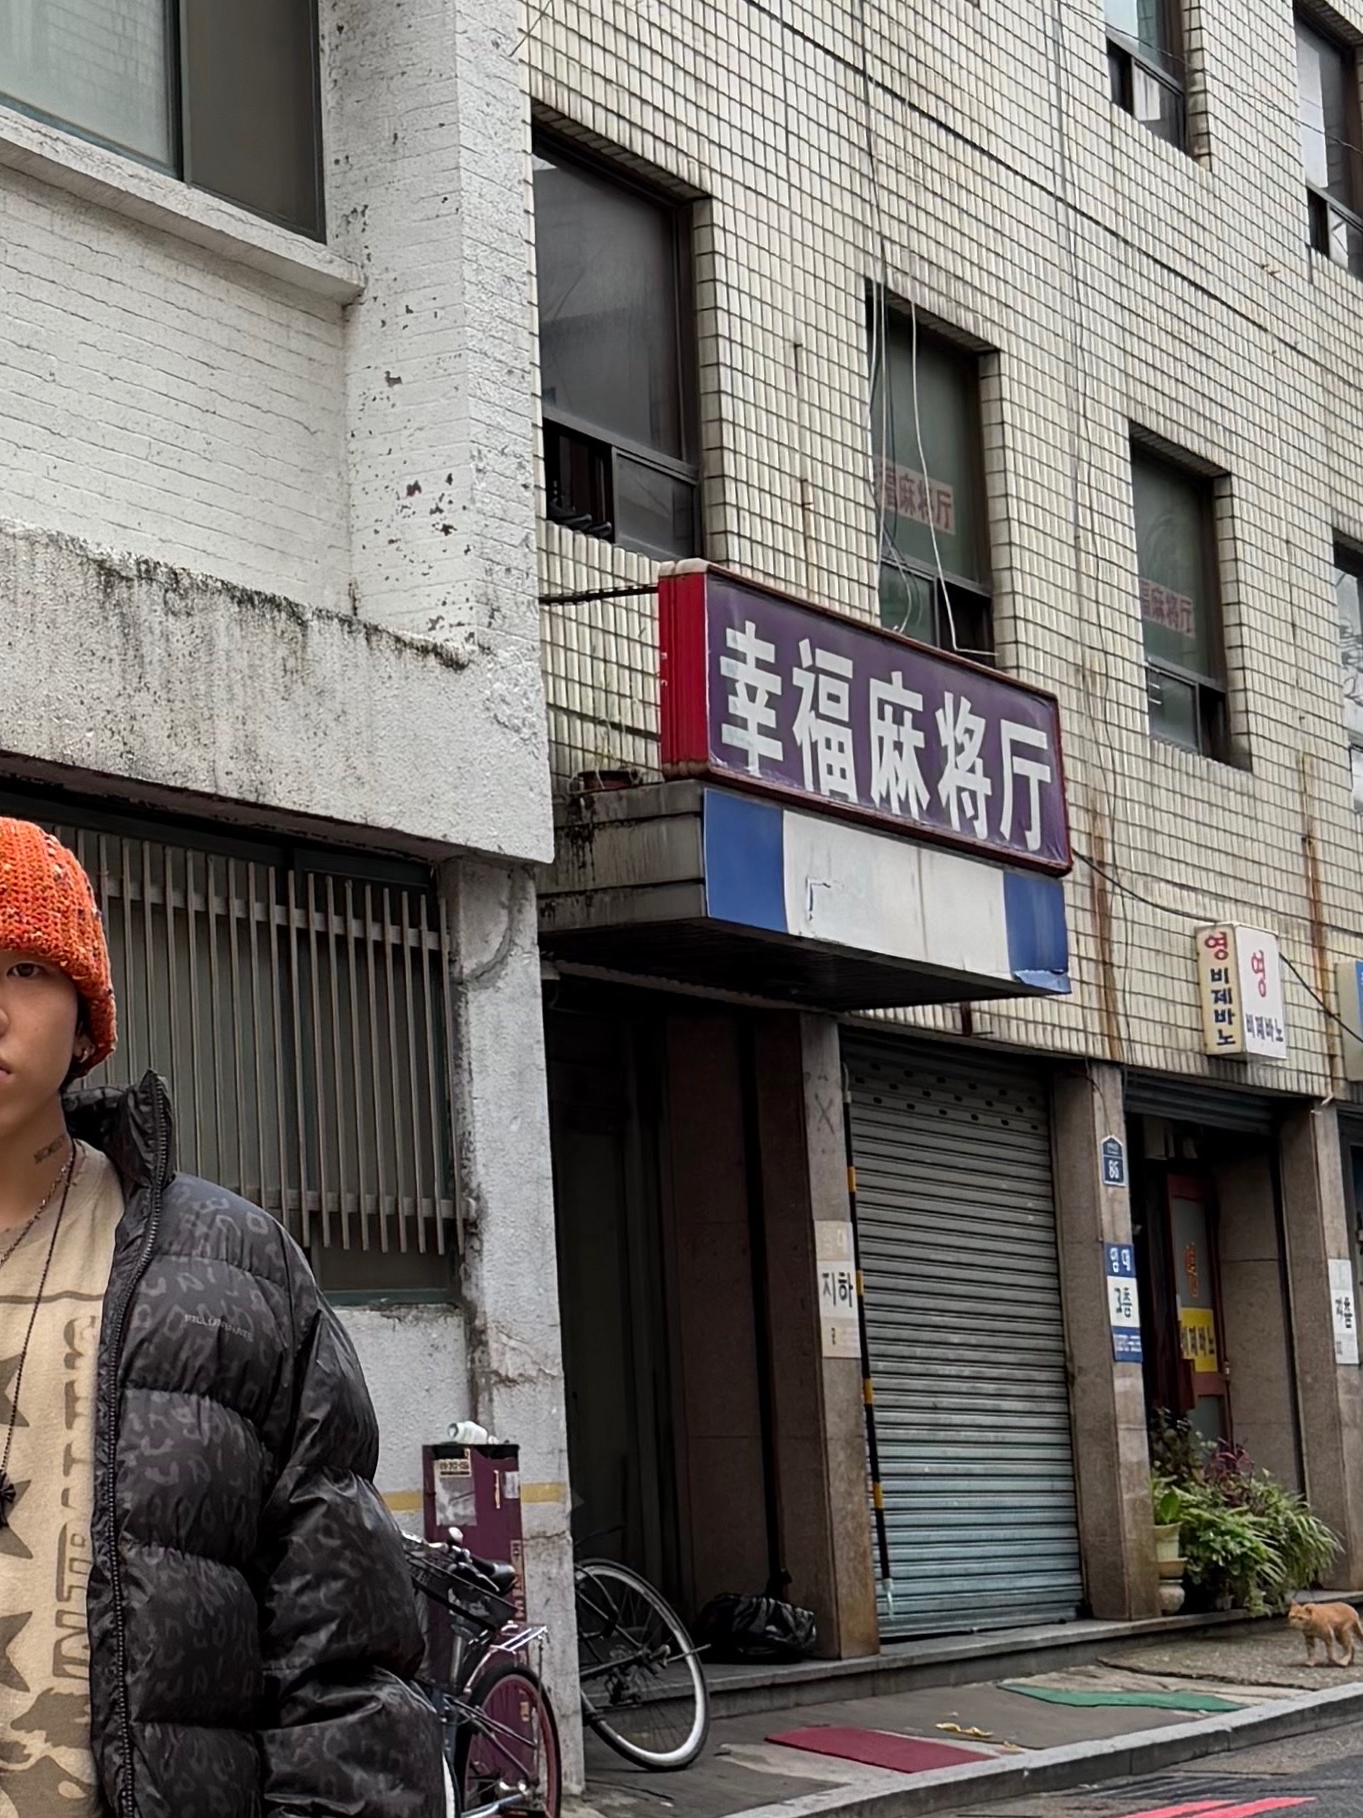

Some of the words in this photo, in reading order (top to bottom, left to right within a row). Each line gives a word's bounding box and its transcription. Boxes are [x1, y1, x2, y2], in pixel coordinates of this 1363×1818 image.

[720, 620, 1052, 851] 幸福麻将厅
[1204, 931, 1229, 961] 영
[1251, 949, 1267, 998] 영
[1210, 967, 1236, 1046] 비제바노
[1245, 1013, 1284, 1043] 비제바노
[822, 1271, 853, 1308] 지하
